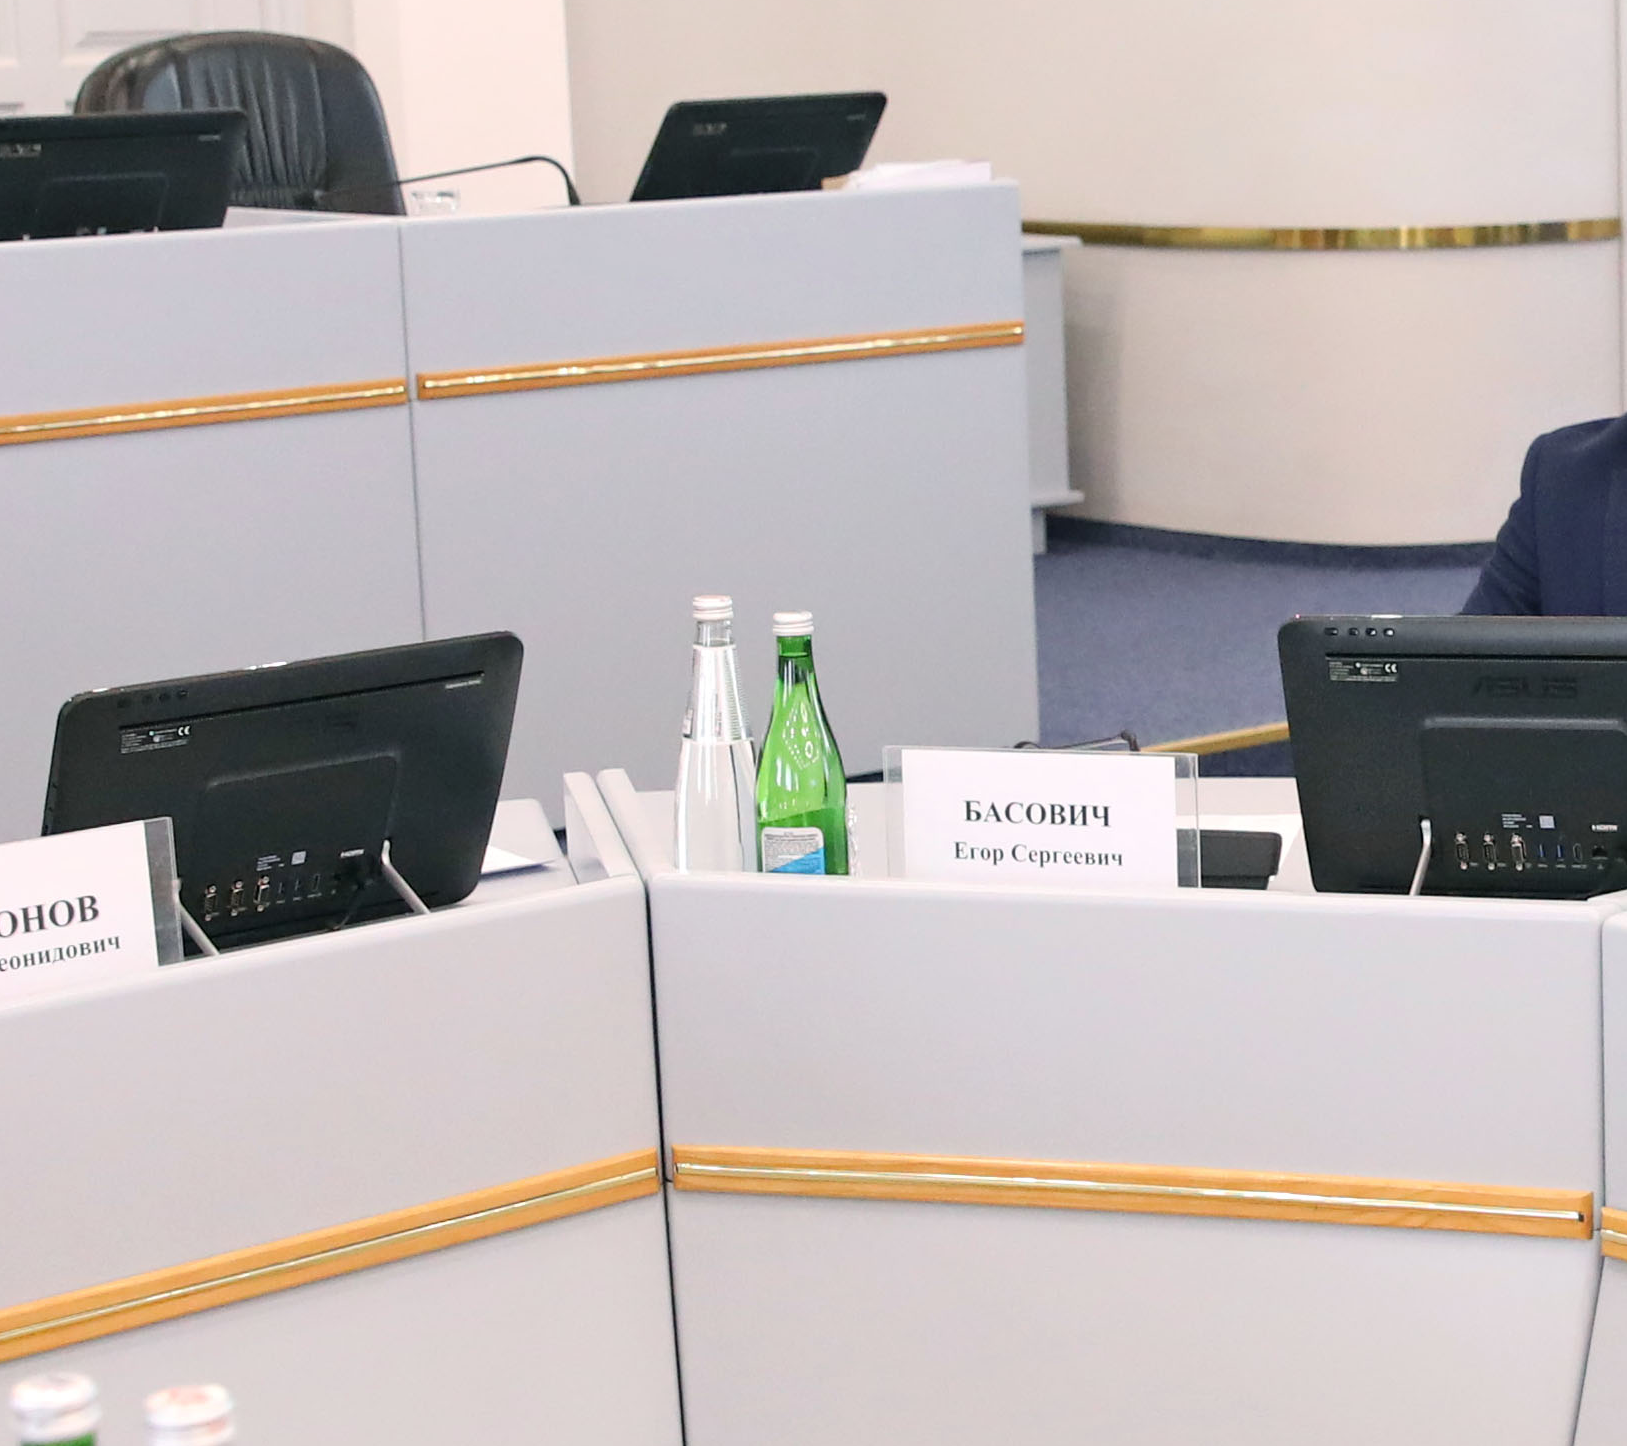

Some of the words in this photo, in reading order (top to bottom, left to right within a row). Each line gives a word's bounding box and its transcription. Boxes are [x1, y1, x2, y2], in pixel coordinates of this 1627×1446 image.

[1471, 674, 1578, 699] ASUS
[964, 799, 1111, 828] БАСОВИЧ
[954, 841, 1005, 866] Егор
[1011, 843, 1123, 869] Сергеевич
